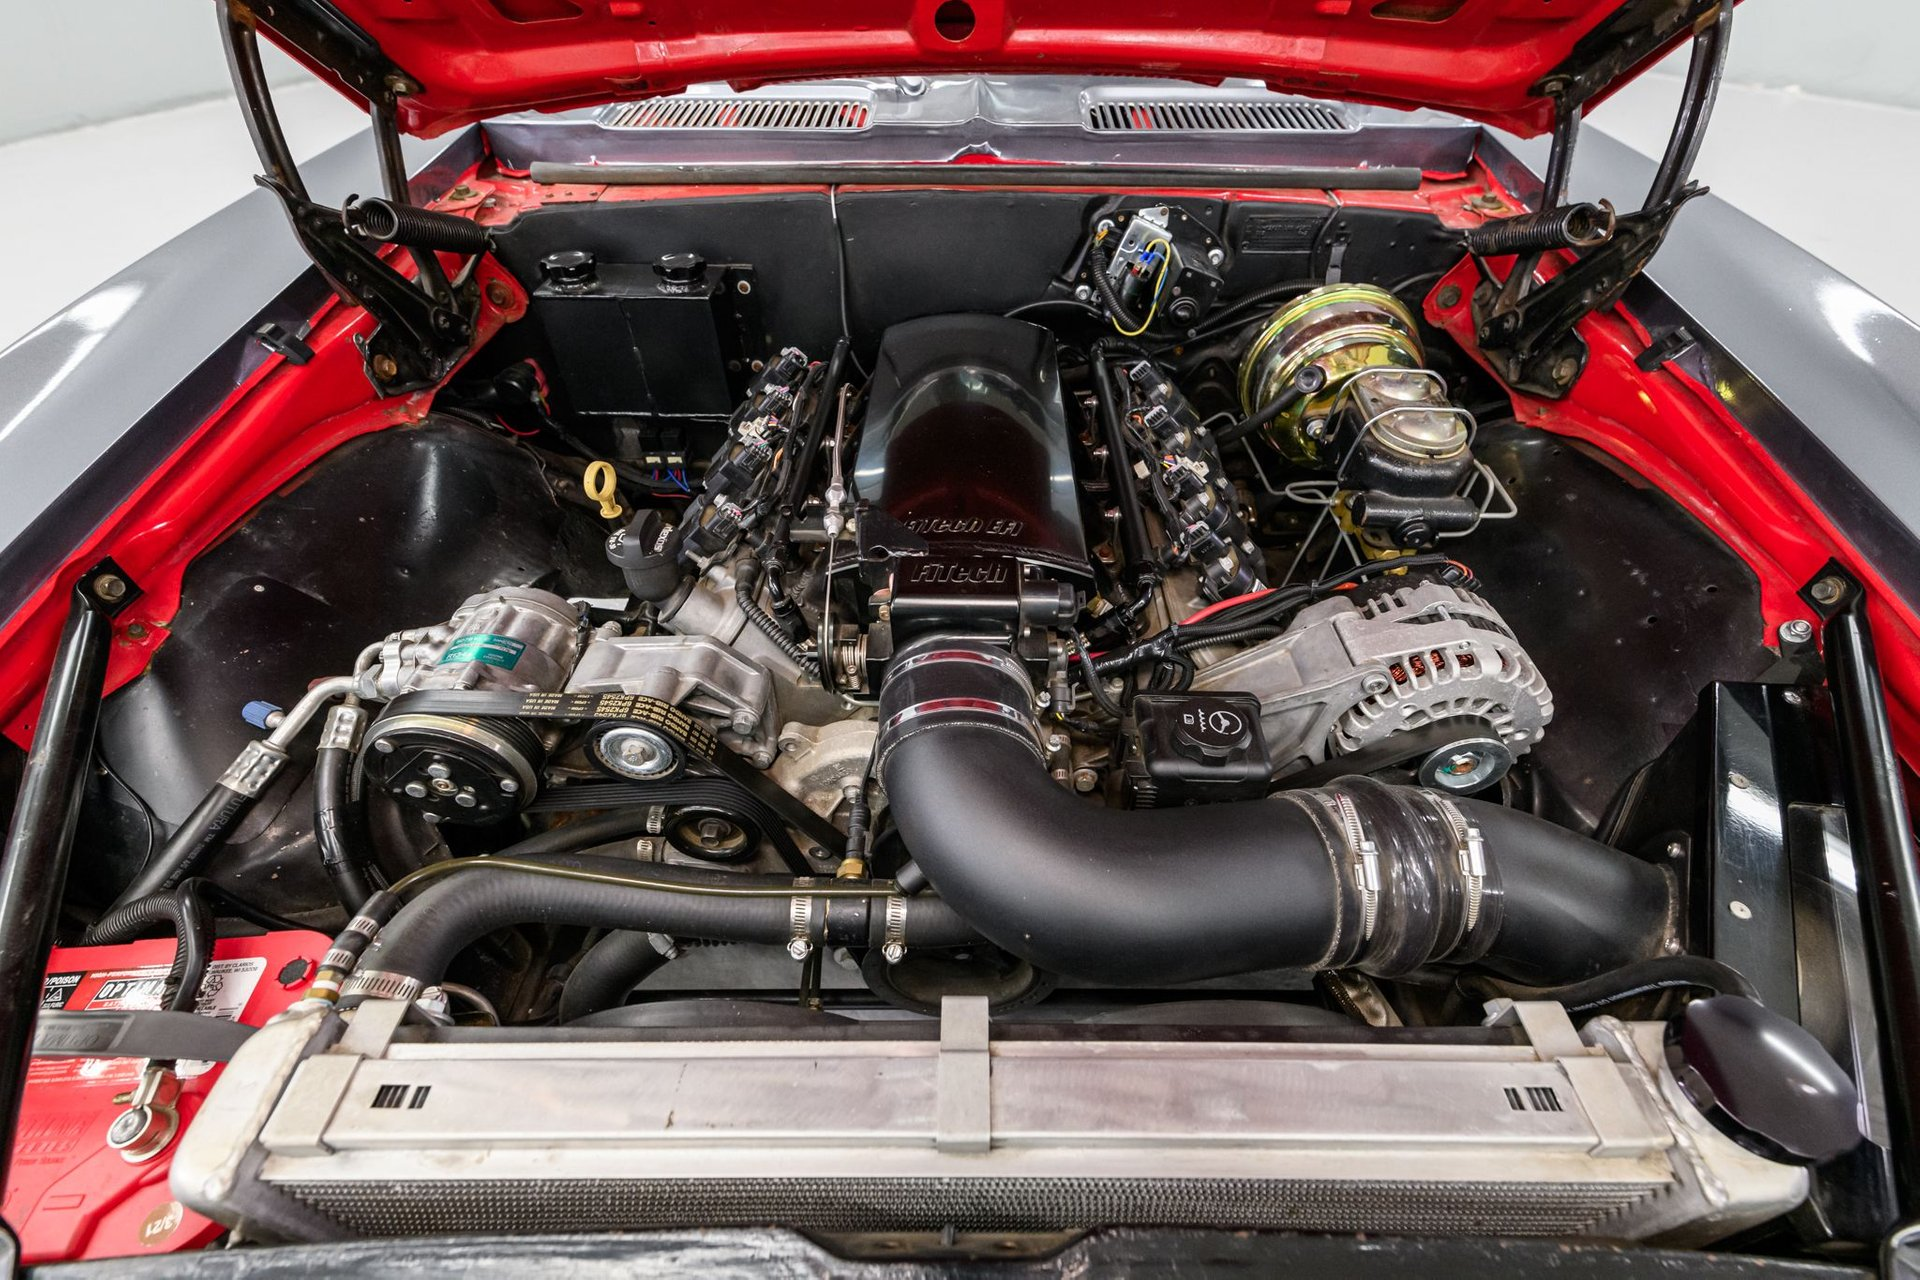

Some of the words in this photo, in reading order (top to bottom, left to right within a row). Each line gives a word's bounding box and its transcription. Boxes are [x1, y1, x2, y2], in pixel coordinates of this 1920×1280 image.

[986, 519, 1024, 536] EFI
[602, 693, 635, 701] 6PK2545
[637, 696, 670, 709] RIB-ACE
[632, 708, 665, 722] RIB-ACE
[635, 702, 667, 715] RIB-ACE
[669, 706, 692, 725] BANDO
[664, 719, 688, 738] BANDO
[667, 712, 690, 731] BANDO
[208, 795, 248, 830] FUTURA
